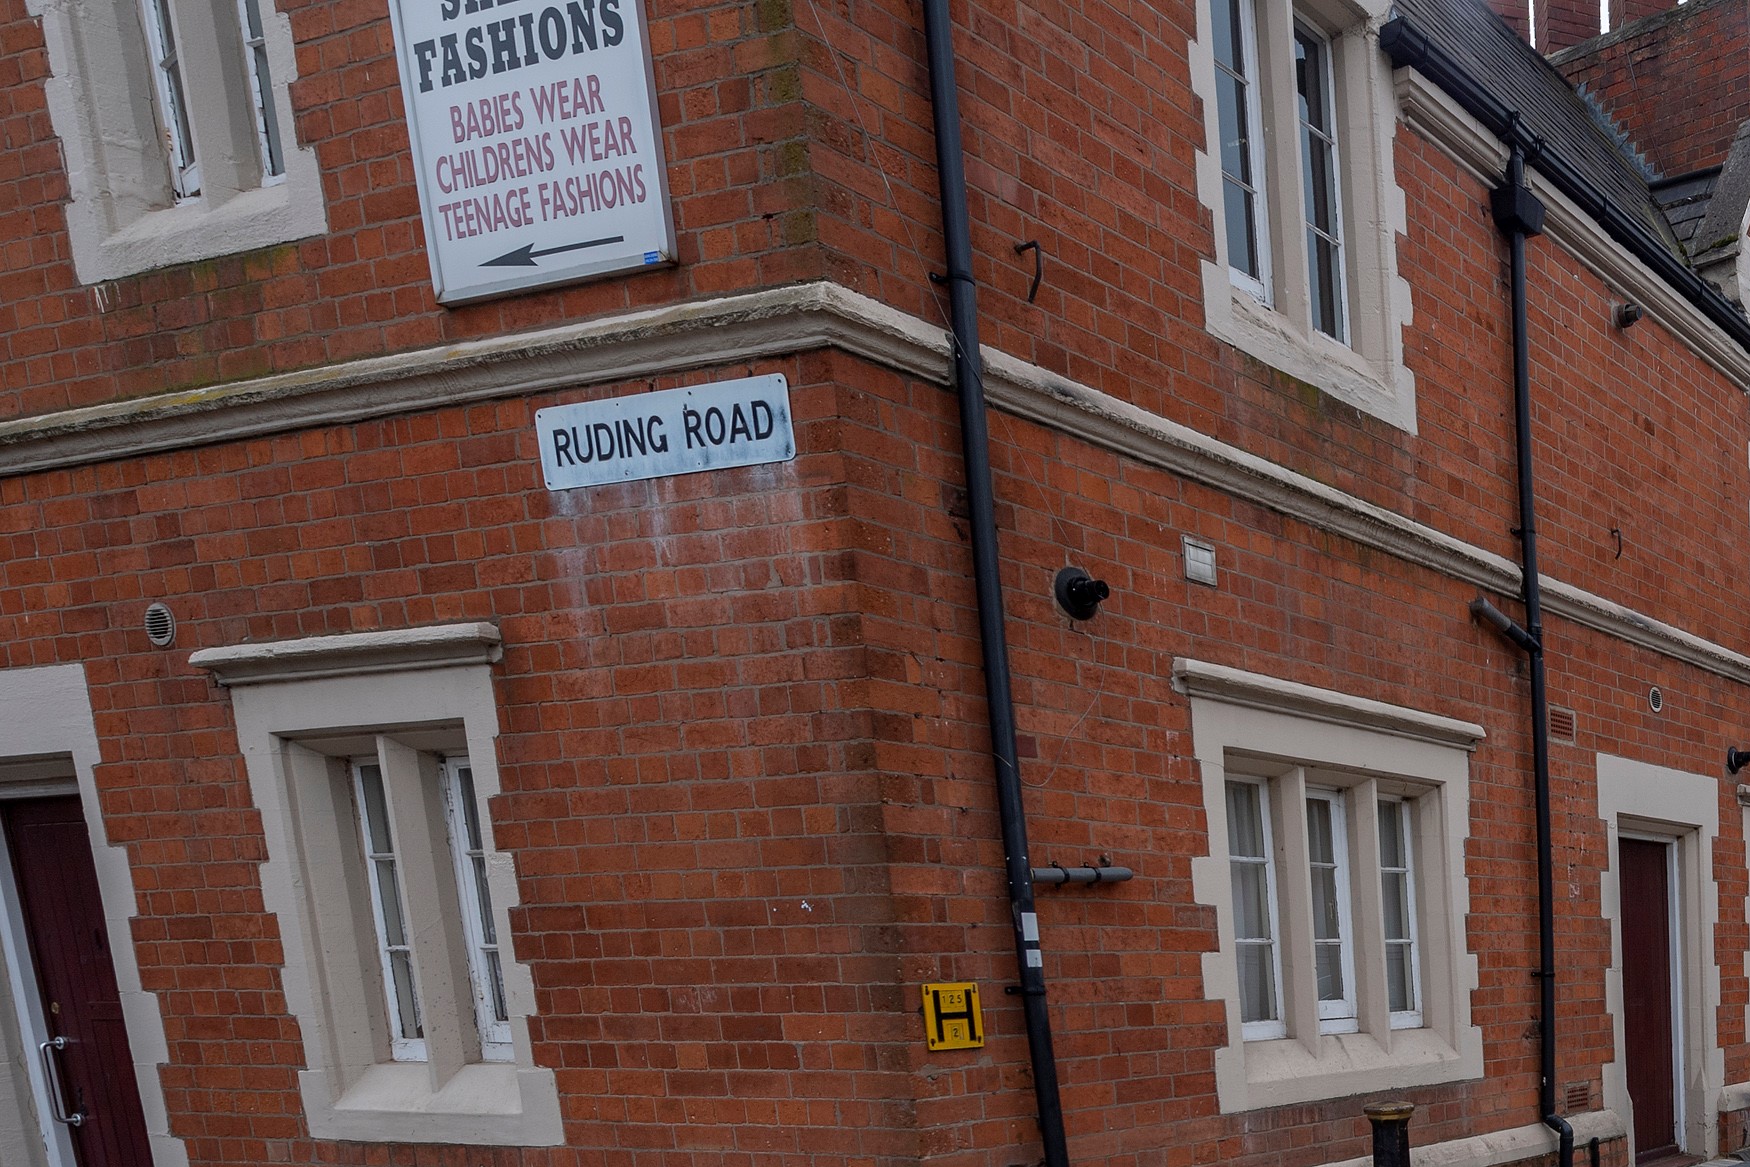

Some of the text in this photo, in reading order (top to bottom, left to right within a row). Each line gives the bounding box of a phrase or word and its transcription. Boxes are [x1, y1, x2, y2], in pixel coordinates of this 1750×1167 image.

[413, 0, 624, 93] FASHIONS
[449, 74, 605, 144] BABIES WEAR
[436, 116, 637, 193] CHILDRENS WEAR
[438, 164, 646, 241] TEENAGE FASHIONS
[553, 400, 774, 467] RUDING ROAD
[932, 988, 977, 1043] H
[942, 994, 963, 1005] 125
[953, 1028, 959, 1038] 2
